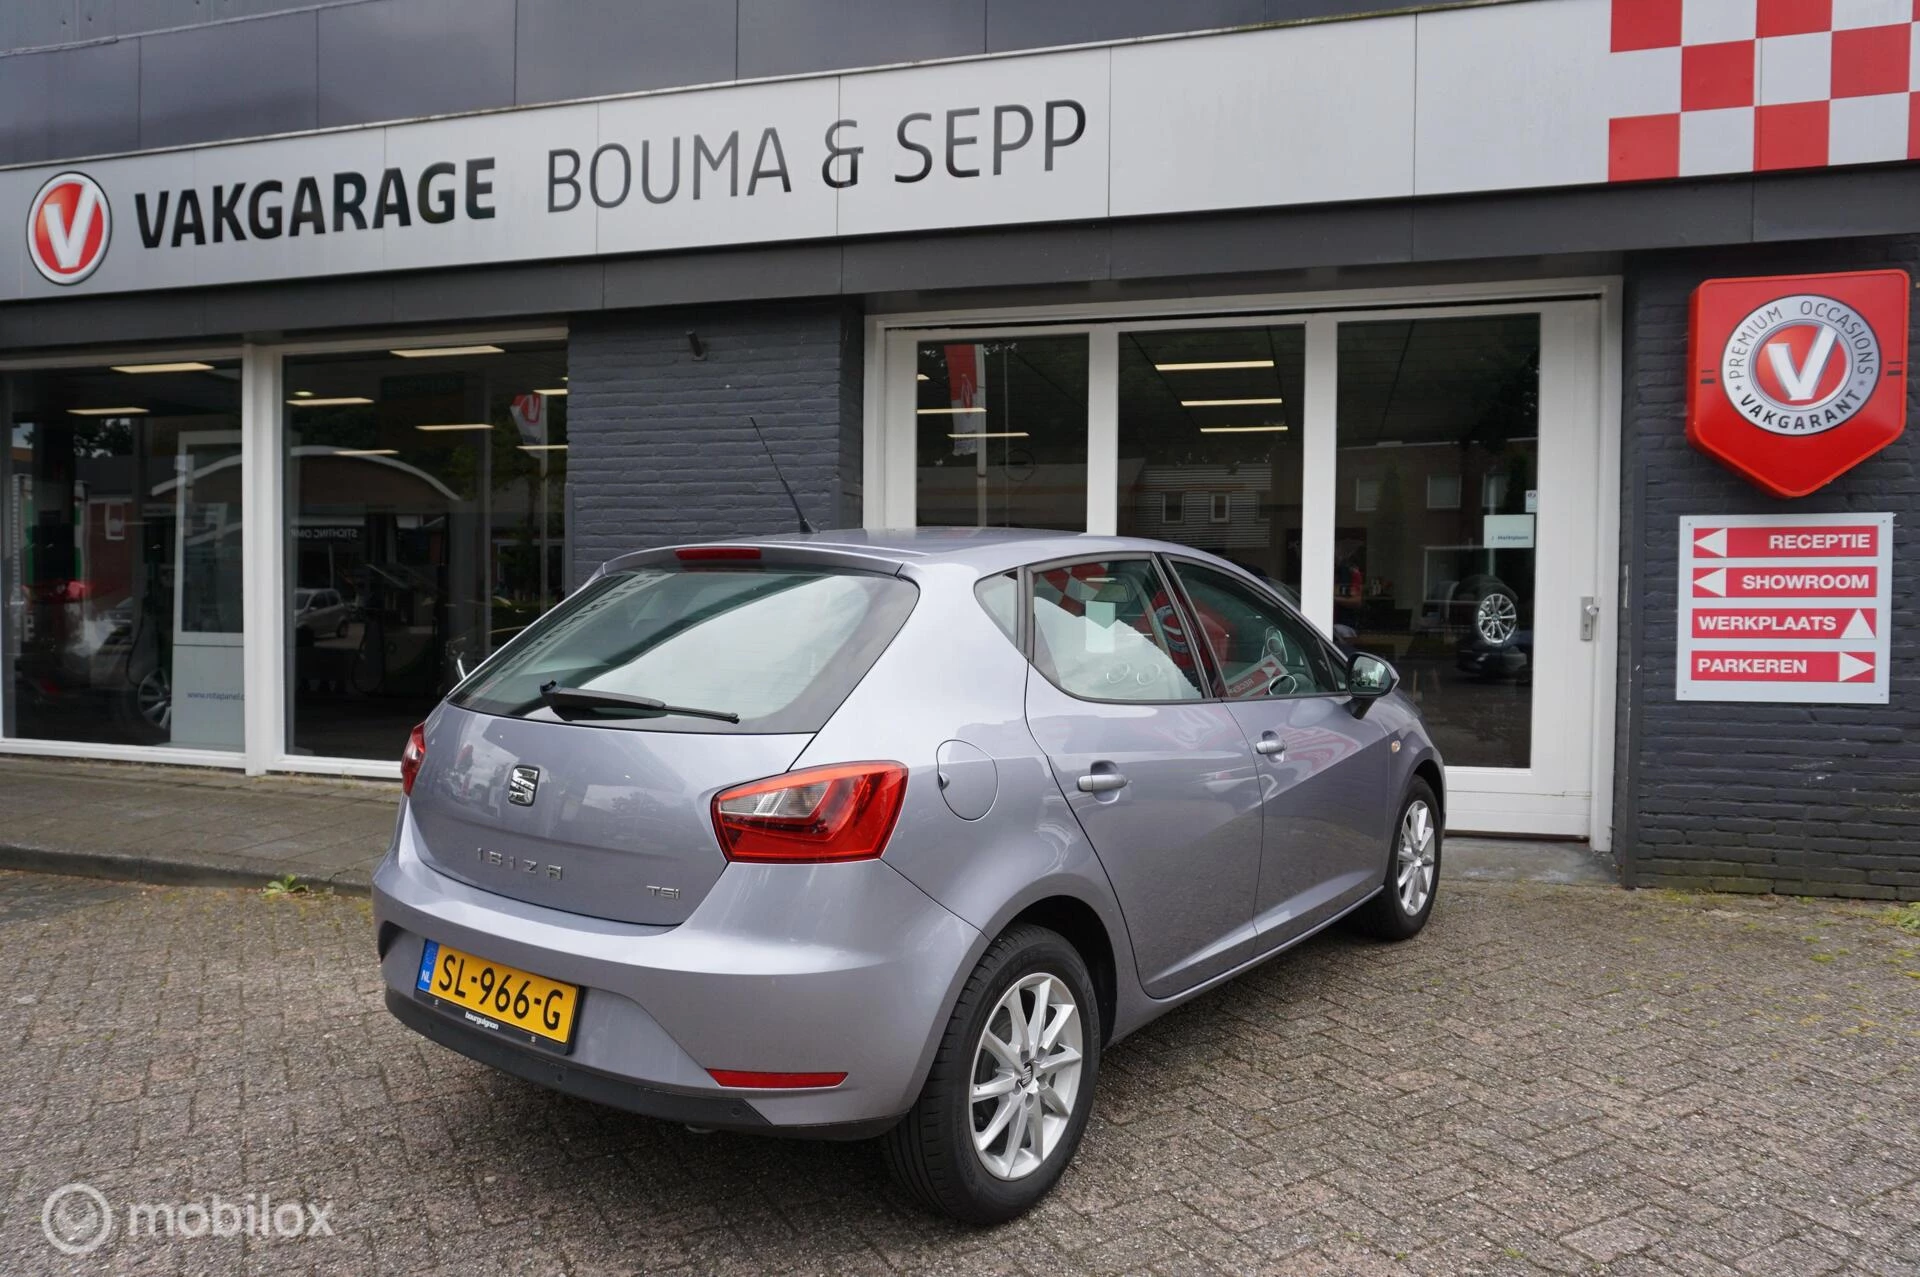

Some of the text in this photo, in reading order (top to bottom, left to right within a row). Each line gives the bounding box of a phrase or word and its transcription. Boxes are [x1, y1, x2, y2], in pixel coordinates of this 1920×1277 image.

[135, 156, 496, 249] VAKGARAGE
[547, 127, 791, 213] BOUMA
[821, 119, 864, 188] &
[894, 99, 1086, 184] SEPP
[1729, 301, 1874, 379] PREMIUM OCCASIONS
[1740, 390, 1861, 430] VAKGARANT
[1769, 534, 1871, 549] RECEPTIE
[1742, 574, 1870, 590] SHOWROOM
[1698, 616, 1837, 631] WERKPLAATS
[1697, 658, 1808, 674] PARKEREN
[477, 847, 562, 880] IBIZA
[421, 954, 563, 1031] NL SL-966-G
